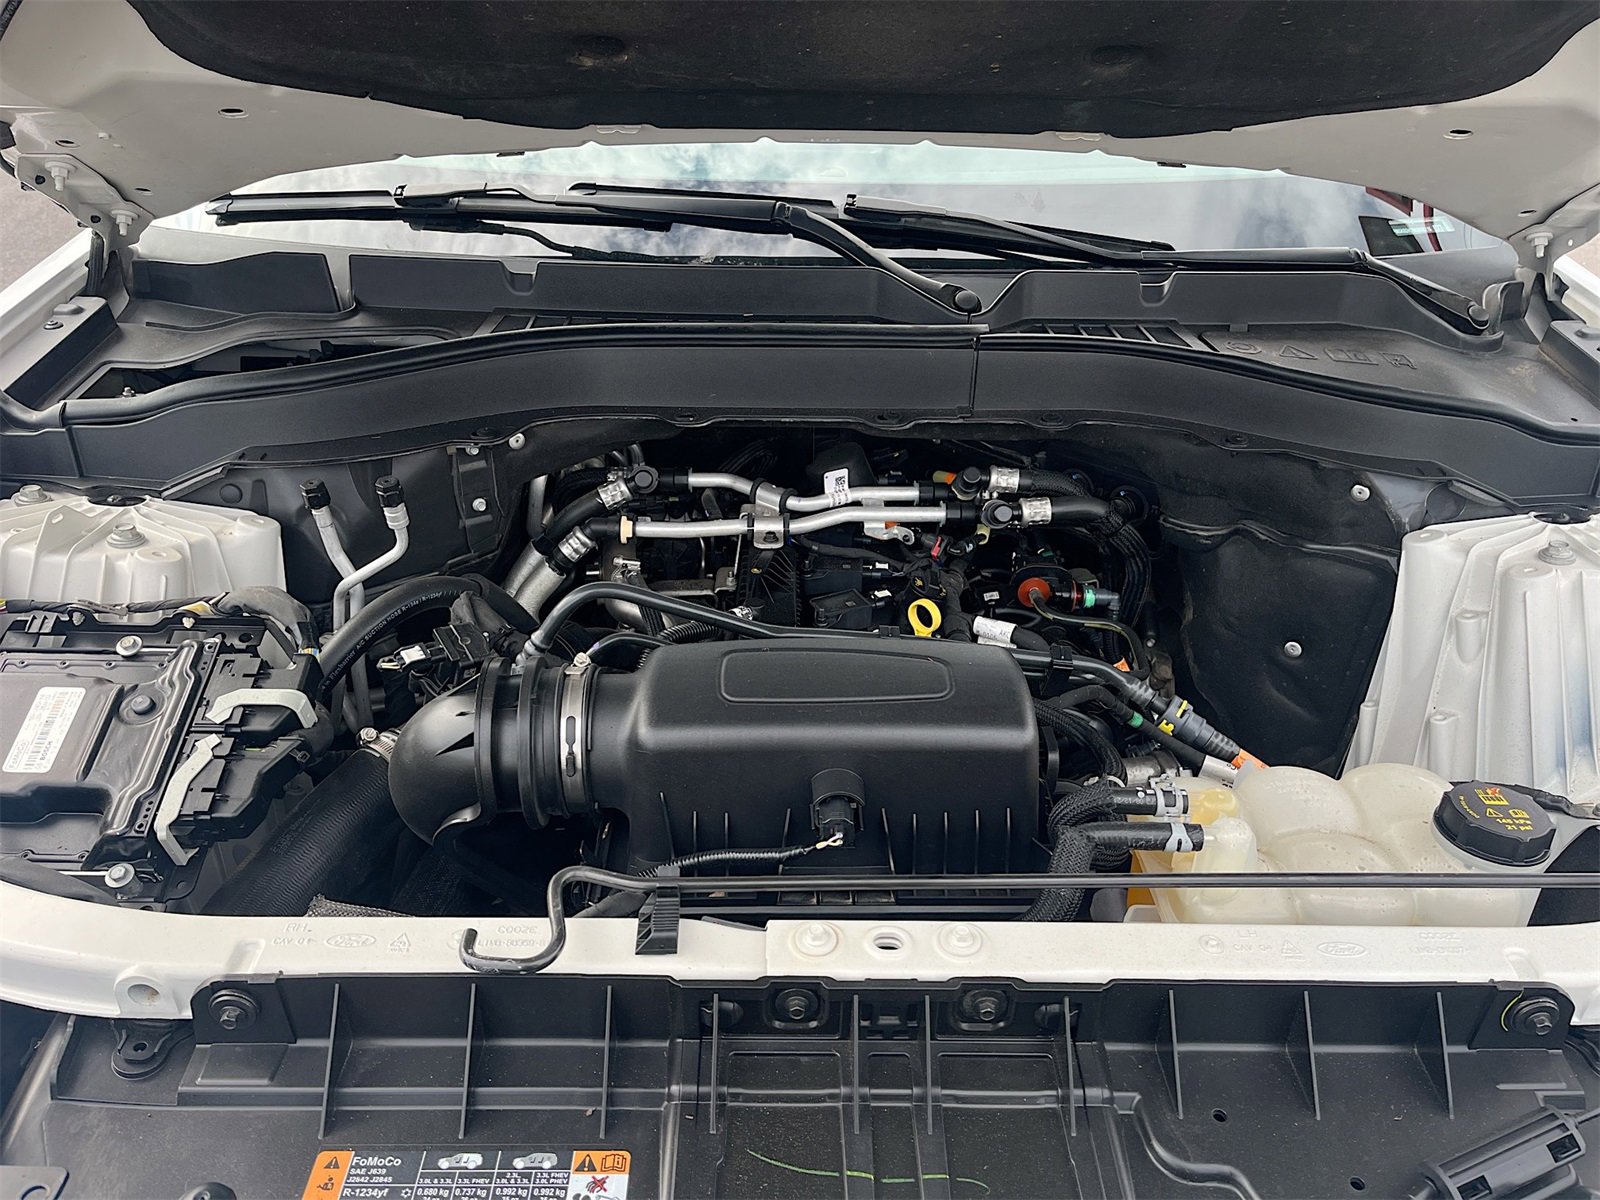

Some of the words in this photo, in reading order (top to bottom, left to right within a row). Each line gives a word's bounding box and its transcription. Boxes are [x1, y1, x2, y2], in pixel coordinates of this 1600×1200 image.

[364, 620, 388, 641] SUCTION
[386, 608, 401, 623] HOSE
[352, 1156, 402, 1166] FoMoCo
[342, 1188, 390, 1199] R-1234yf
[417, 1187, 438, 1196] 0.680
[438, 1187, 449, 1198] kg
[454, 1187, 476, 1196] 0.737
[476, 1187, 487, 1198] kg
[495, 1187, 517, 1196] 0.992
[517, 1187, 528, 1198] kg
[533, 1187, 555, 1196] 0.992
[555, 1187, 566, 1198] kg
